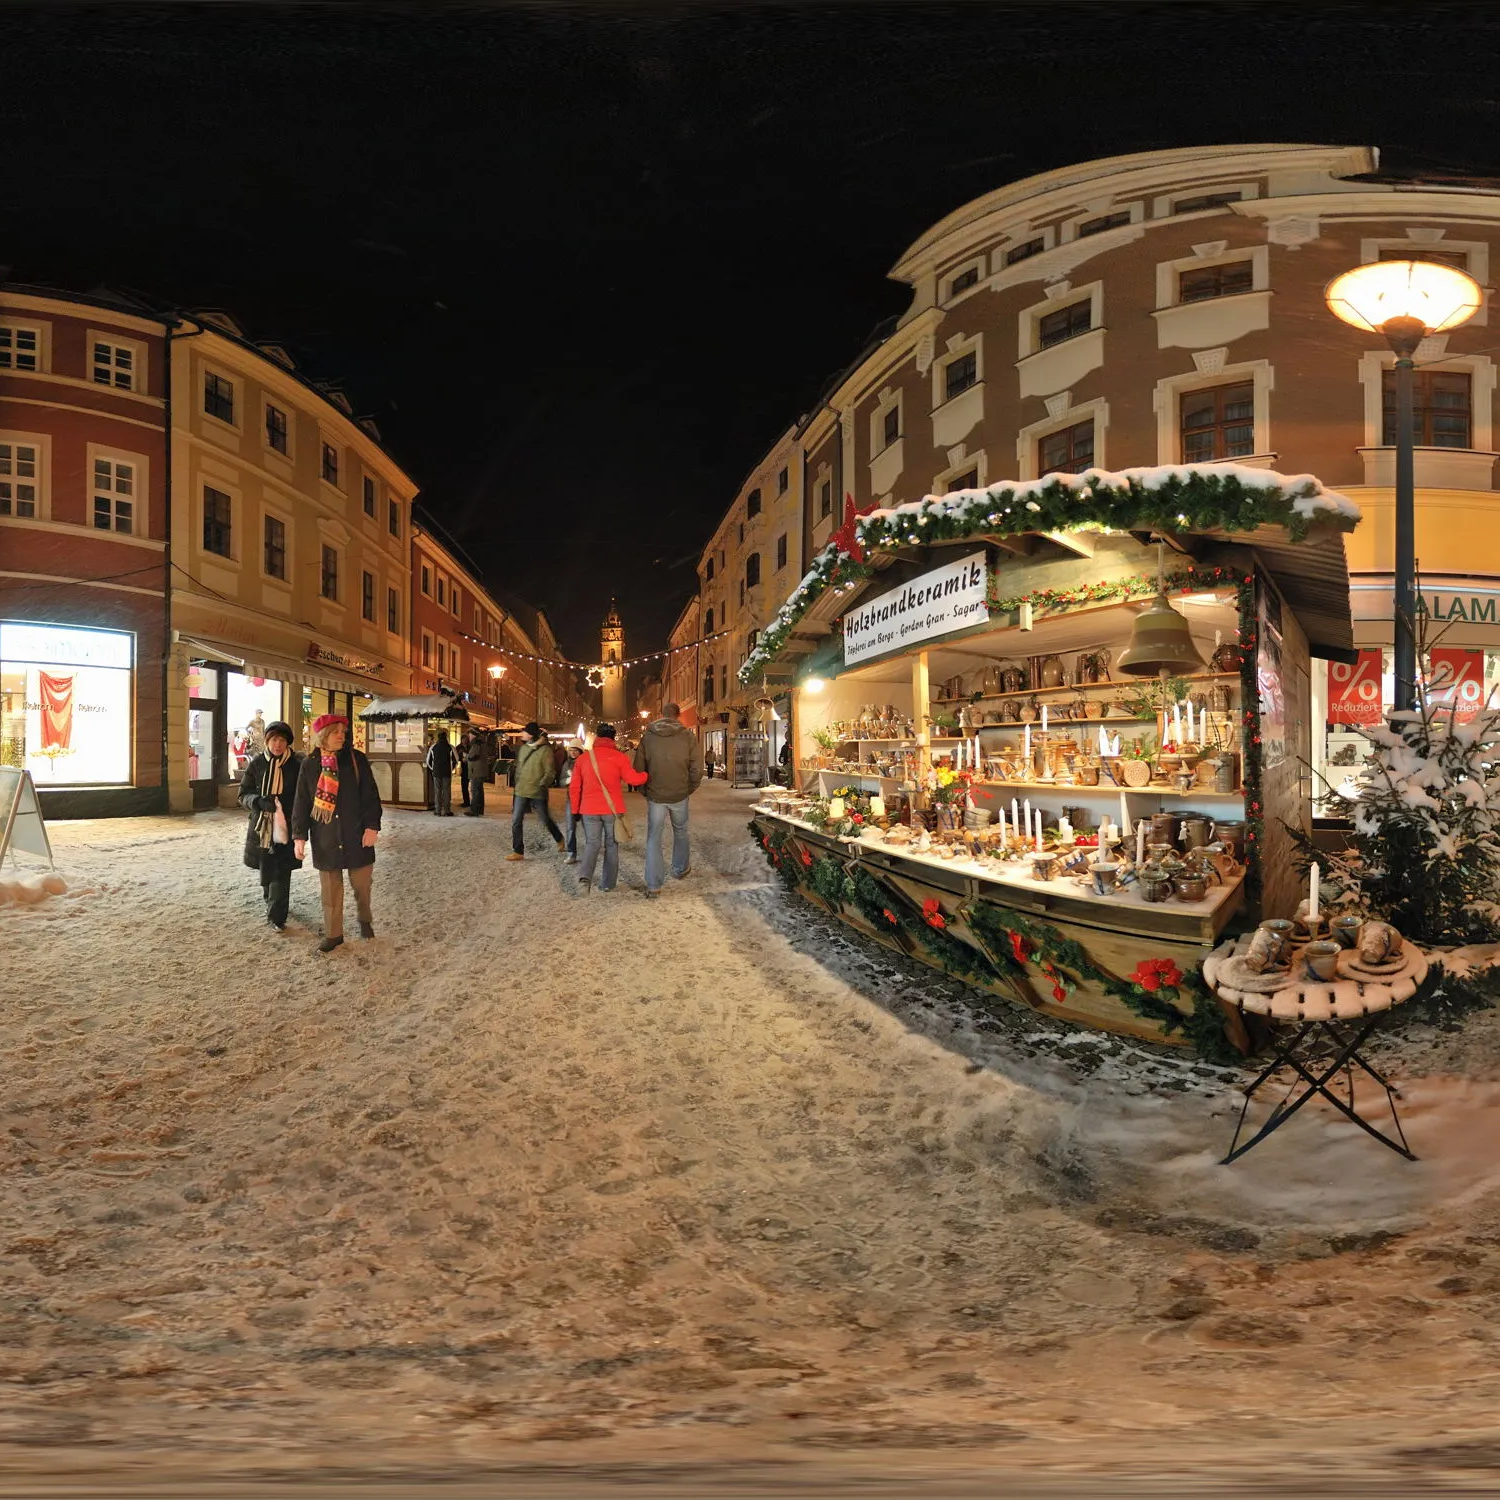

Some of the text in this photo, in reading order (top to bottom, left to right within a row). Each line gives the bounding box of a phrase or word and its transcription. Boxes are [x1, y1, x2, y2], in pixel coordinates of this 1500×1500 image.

[846, 561, 981, 638] Holzbrandkeramik
[1412, 595, 1496, 622] ALAM
[867, 638, 876, 648] am
[877, 631, 894, 644] Berge
[900, 619, 924, 637] Gordon
[926, 613, 945, 626] Gran
[953, 602, 979, 617] Sagar
[1331, 702, 1378, 712] Reduziert
